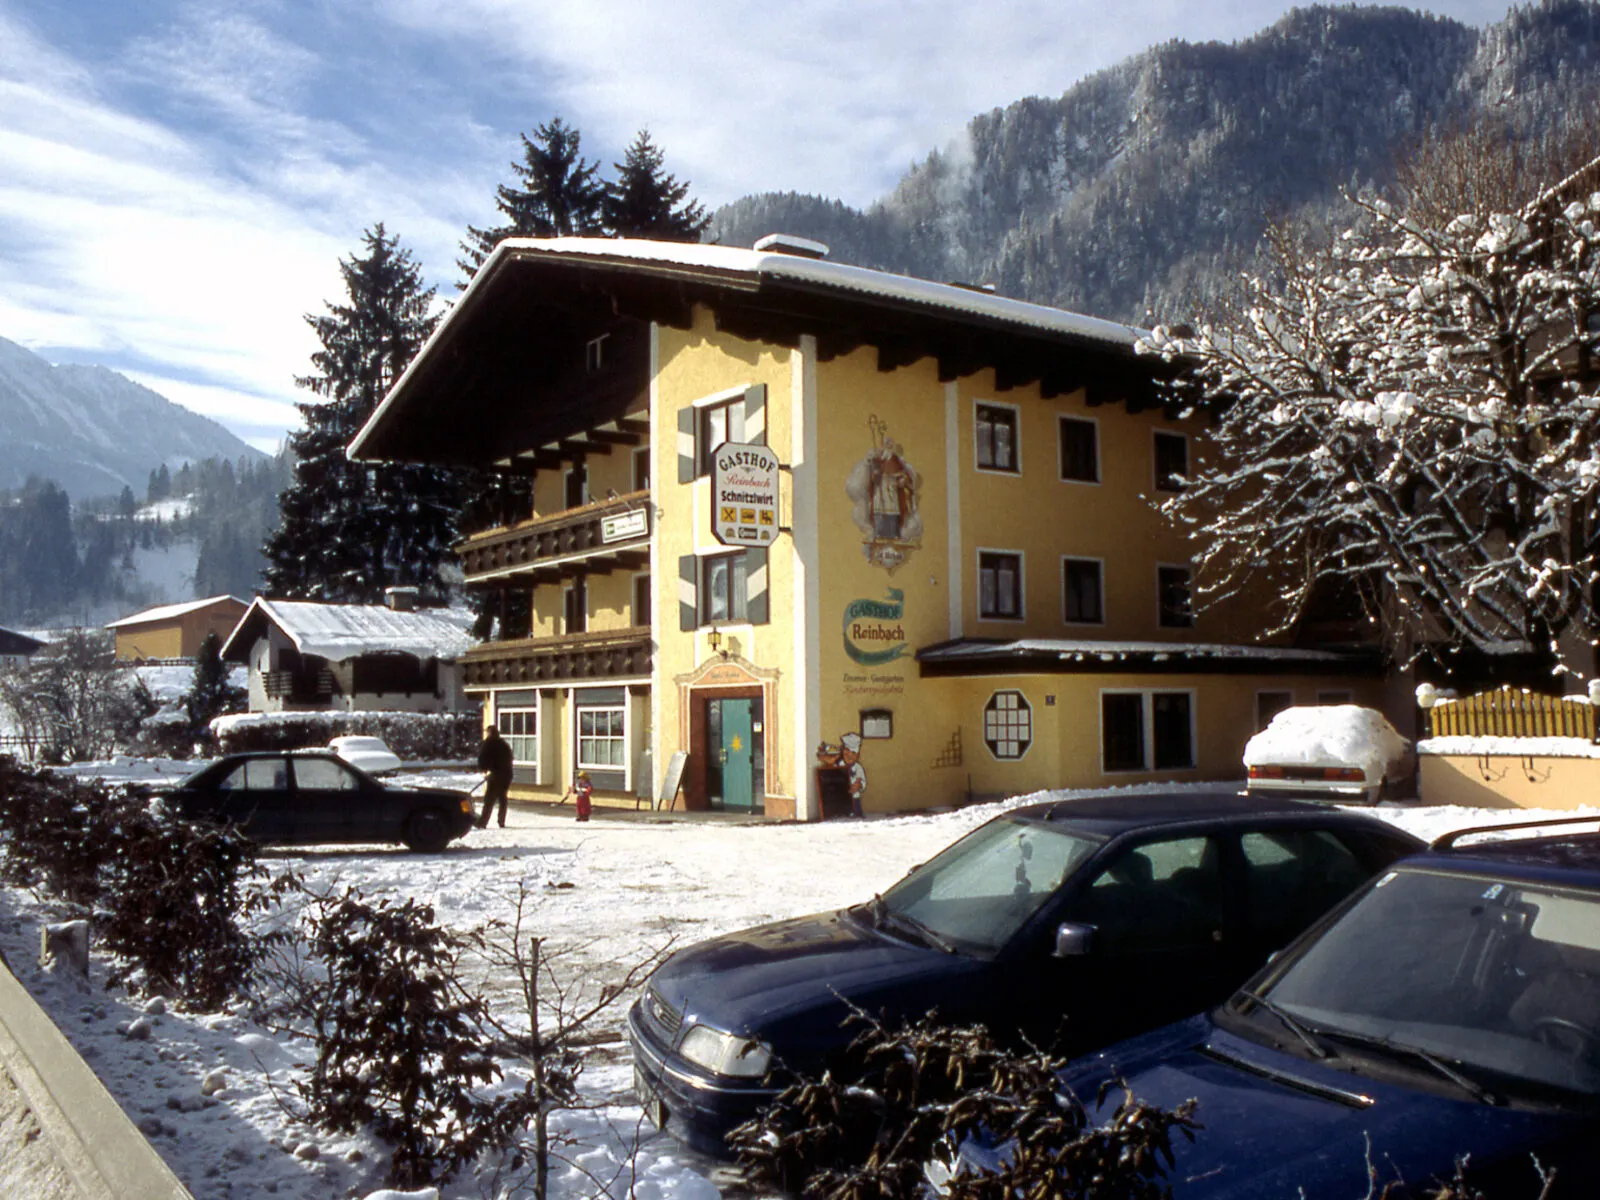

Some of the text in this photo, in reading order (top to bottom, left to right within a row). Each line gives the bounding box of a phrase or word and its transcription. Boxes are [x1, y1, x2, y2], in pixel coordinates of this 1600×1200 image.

[719, 452, 776, 473] GASTHOF
[721, 490, 773, 506] Schnitzlwirt
[852, 624, 905, 641] Reinbach
